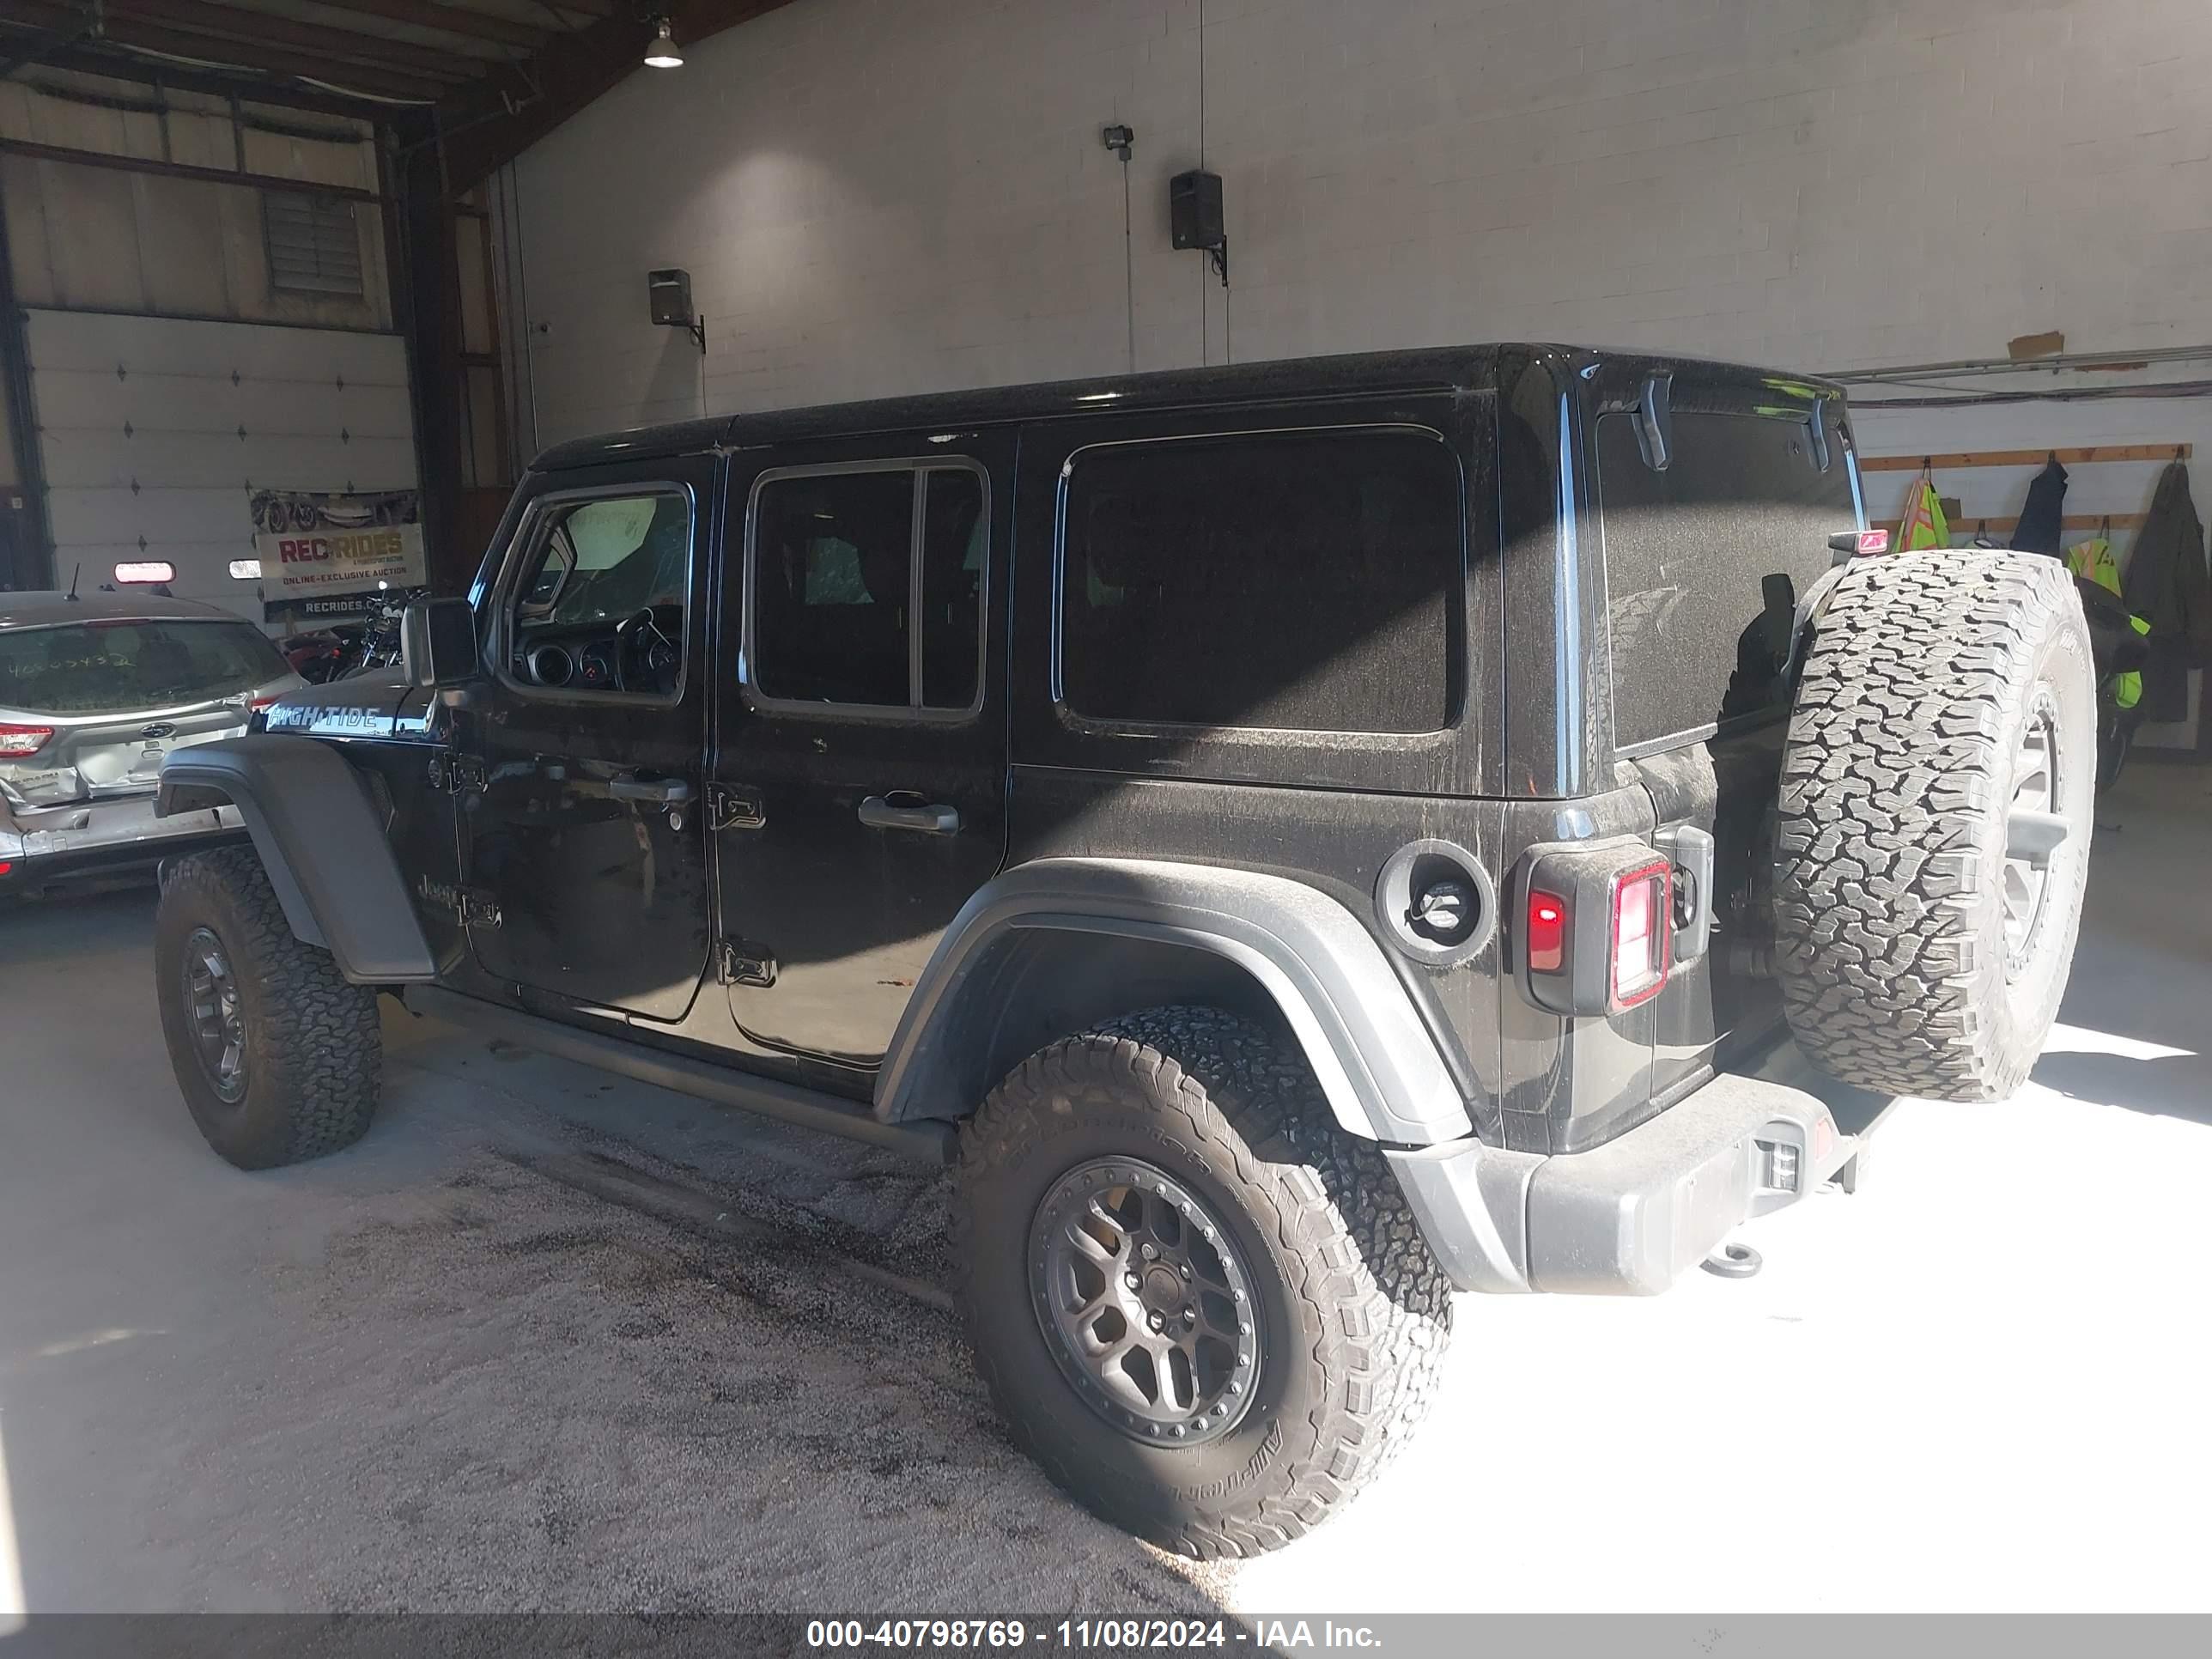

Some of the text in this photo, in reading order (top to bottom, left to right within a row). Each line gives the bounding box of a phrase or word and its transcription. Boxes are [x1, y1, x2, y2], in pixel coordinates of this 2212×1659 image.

[283, 567, 407, 585] ONLINE-EXCLUSIVE AUCTION
[269, 706, 380, 728] HIGH TIDE
